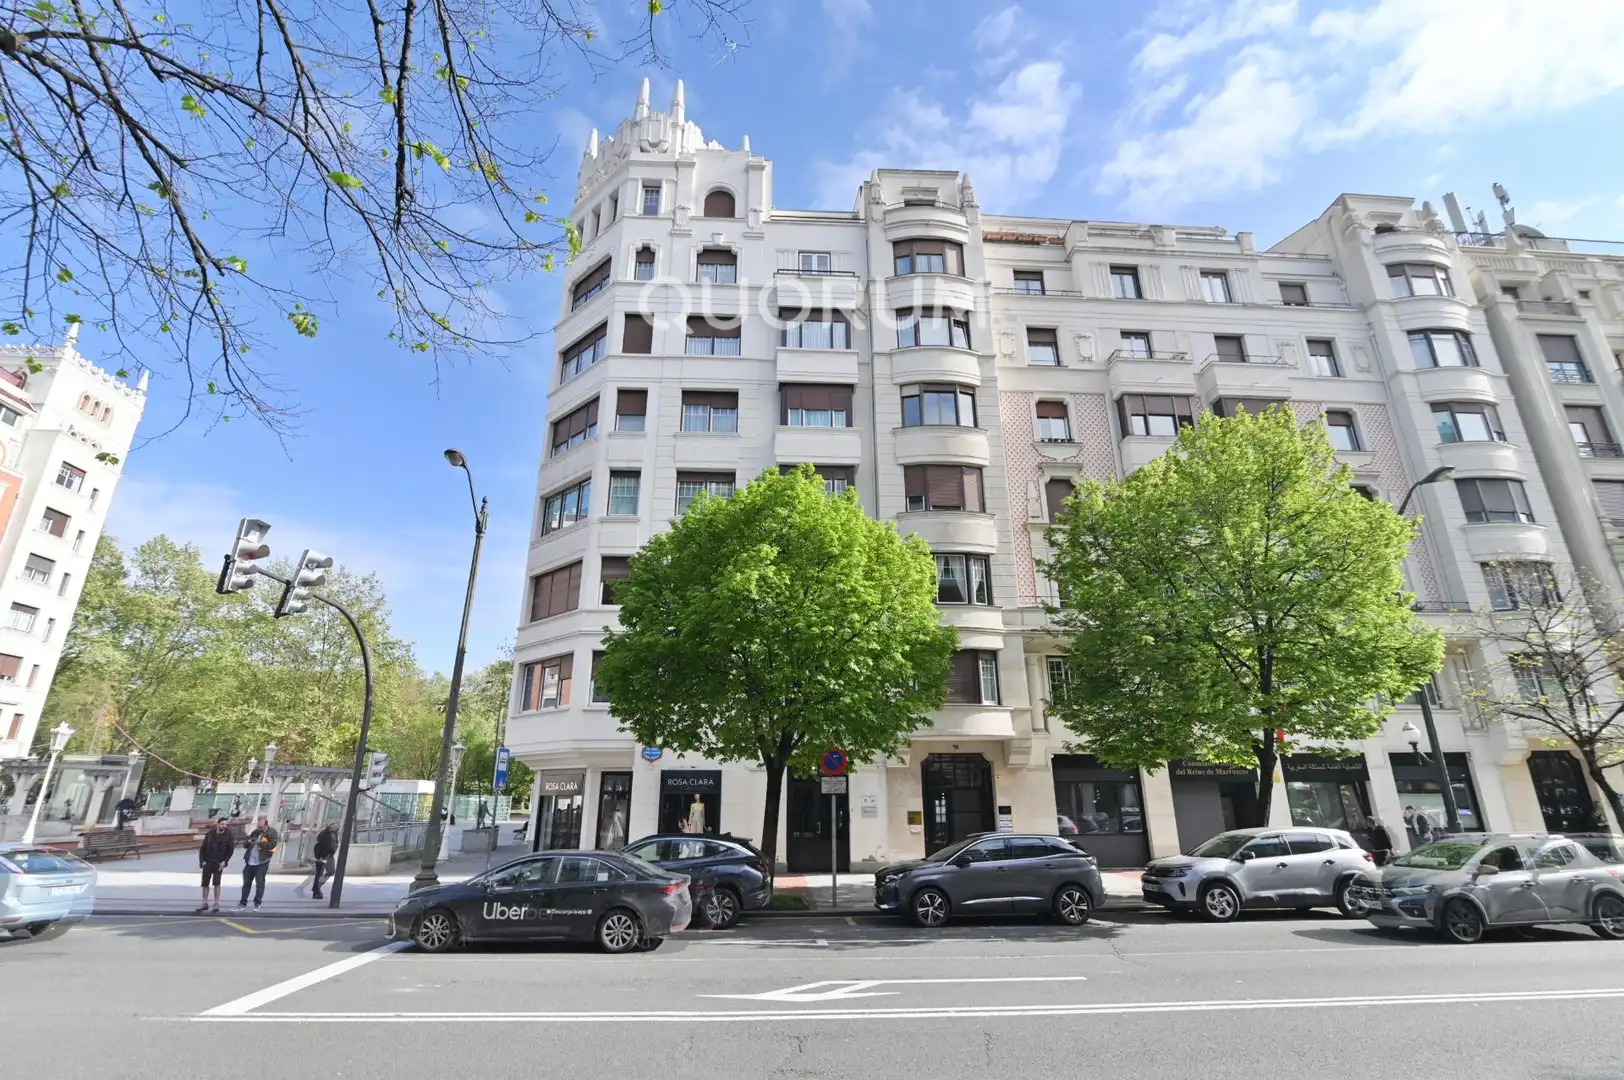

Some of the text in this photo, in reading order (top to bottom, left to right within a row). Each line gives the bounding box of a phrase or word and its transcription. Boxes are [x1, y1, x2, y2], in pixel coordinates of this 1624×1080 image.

[1186, 768, 1205, 776] Reino
[667, 778, 688, 786] ROSA
[545, 782, 559, 791] ROSA
[483, 902, 528, 920] Uber
